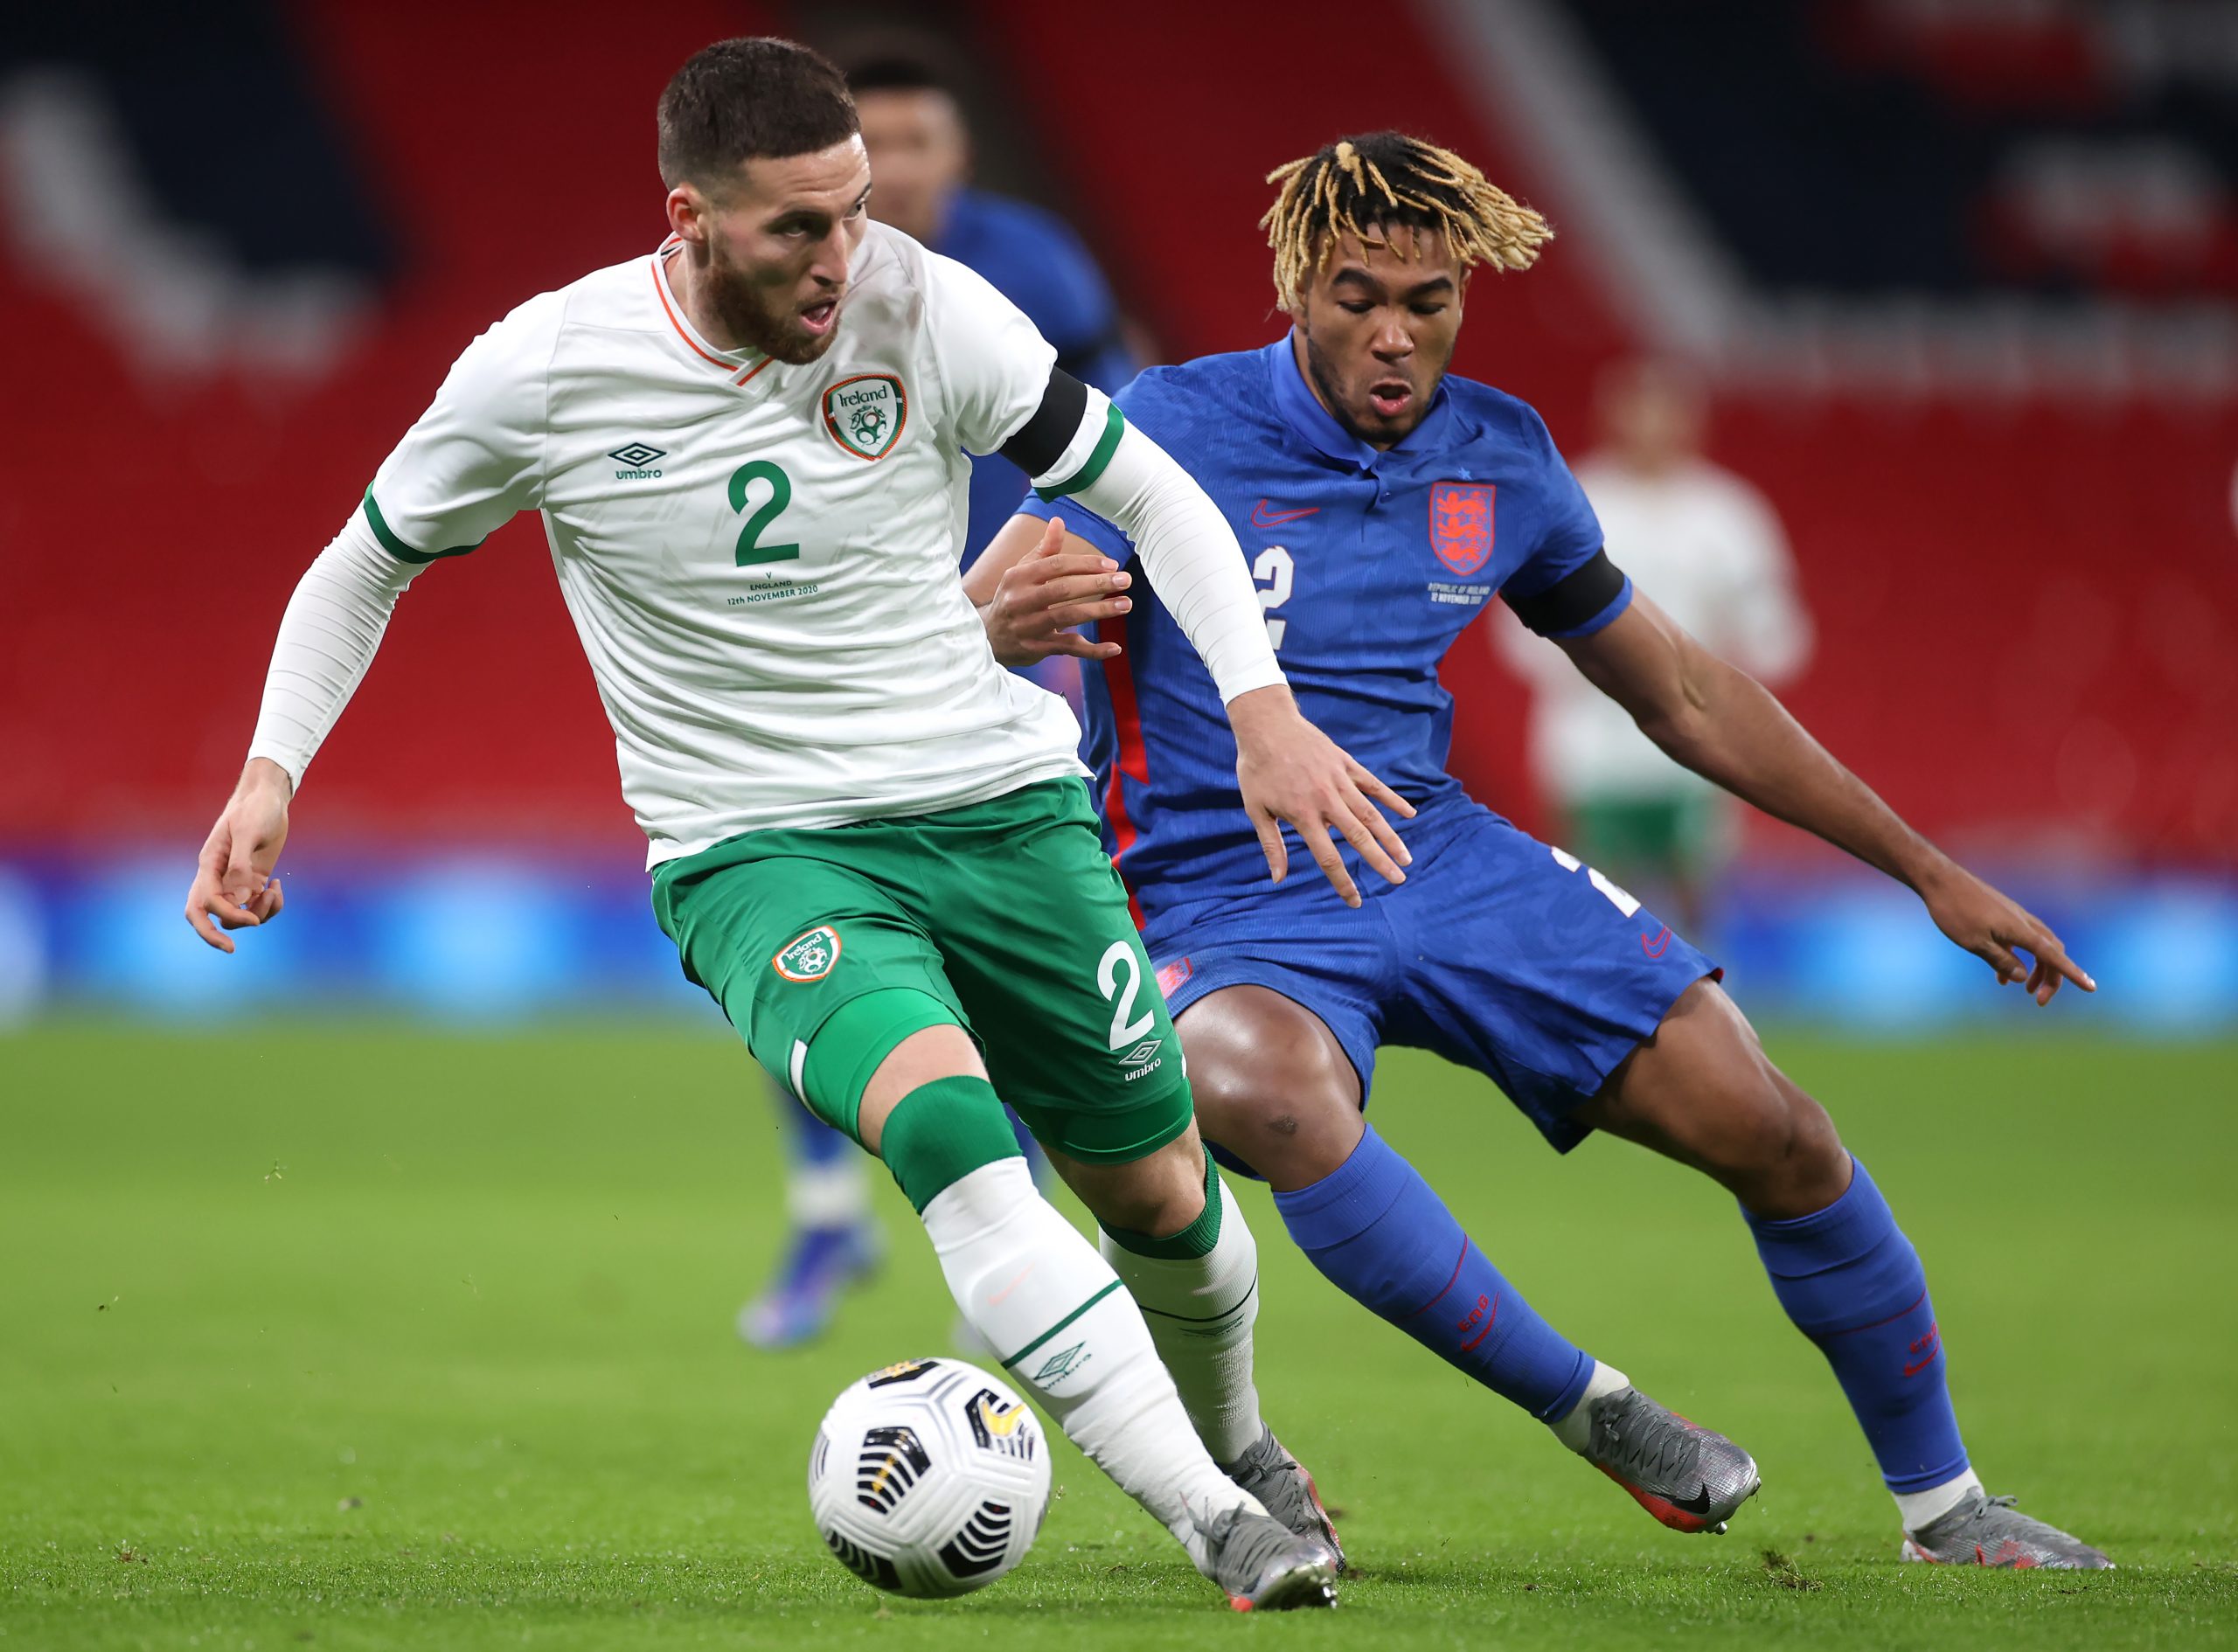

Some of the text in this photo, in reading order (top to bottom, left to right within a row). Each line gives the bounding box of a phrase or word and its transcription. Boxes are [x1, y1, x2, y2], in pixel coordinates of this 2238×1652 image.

[838, 385, 887, 407] Ireland
[615, 469, 663, 480] umbro
[727, 460, 799, 567] 2
[727, 585, 818, 606] 12th NOVEMBER 2020
[749, 580, 792, 591] ENGLAND
[1253, 545, 1294, 650] 2
[785, 933, 823, 961] Ireland
[1097, 941, 1155, 1052] 2
[1124, 1058, 1162, 1082] umbro
